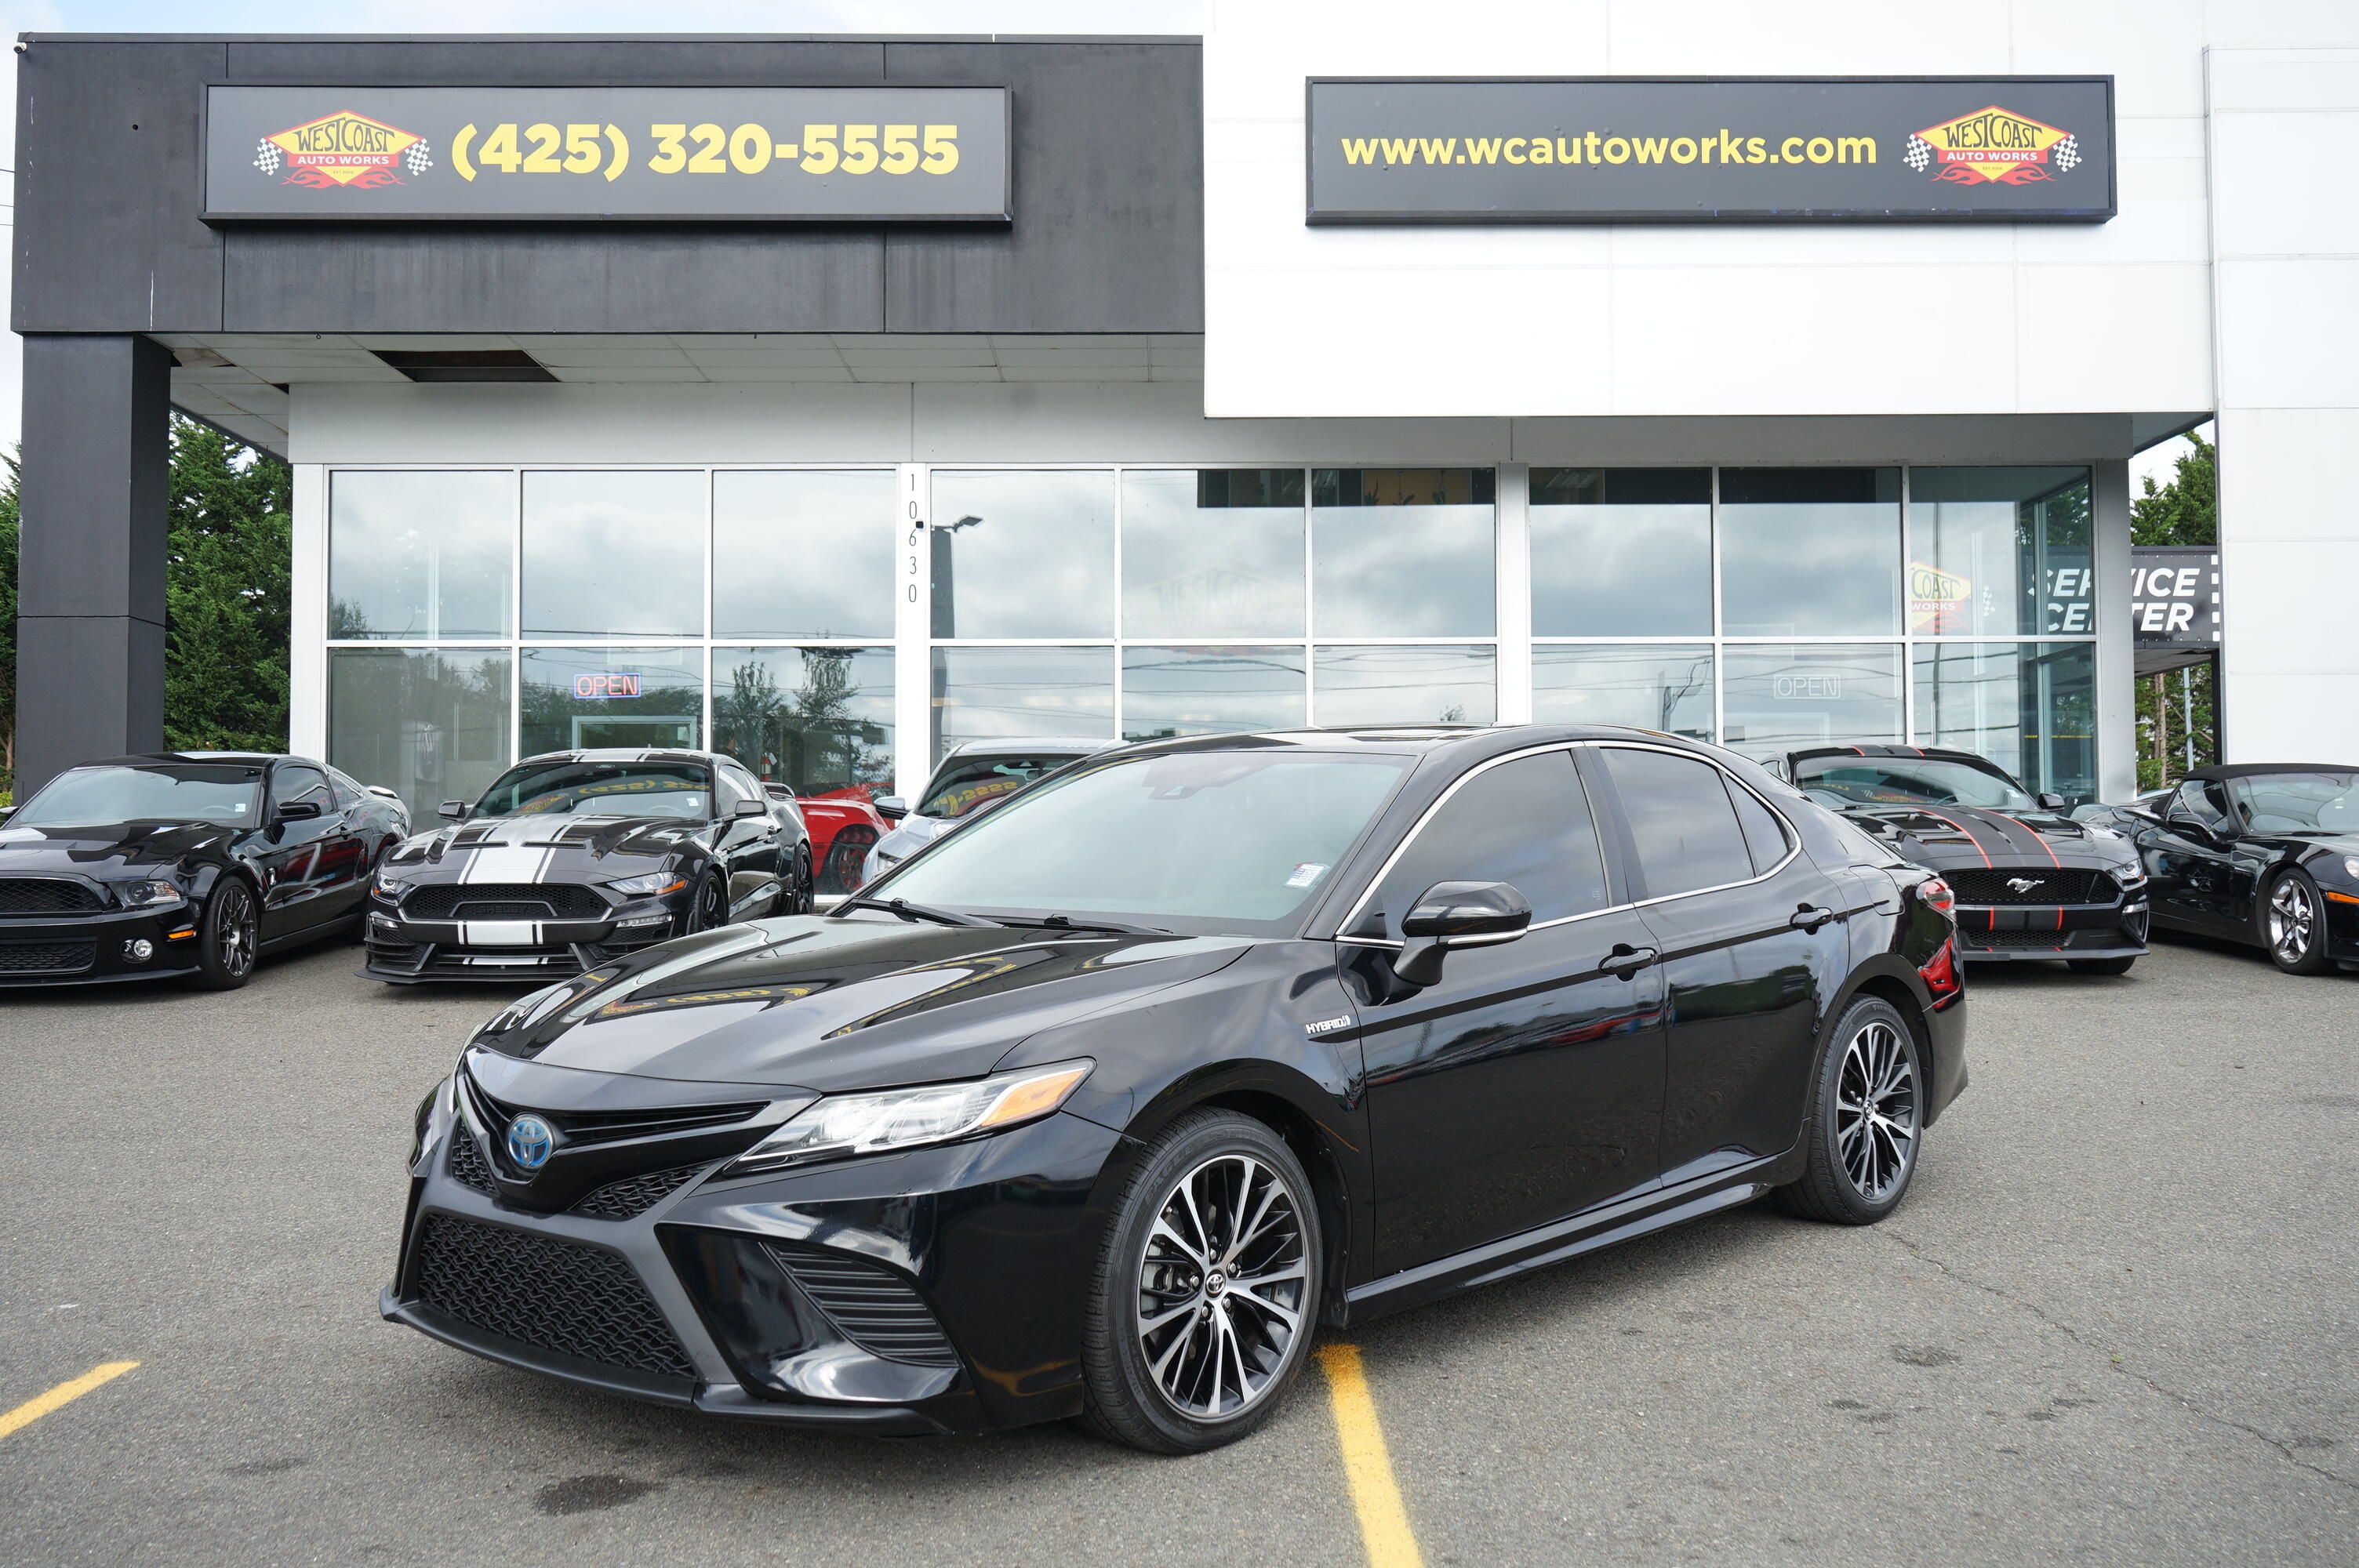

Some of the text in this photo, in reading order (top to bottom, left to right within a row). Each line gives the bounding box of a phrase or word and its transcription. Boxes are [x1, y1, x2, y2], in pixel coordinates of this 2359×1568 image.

[452, 123, 959, 182] (425) 320-5555
[1340, 129, 1877, 165] www.wcautoworks.com
[1946, 151, 2038, 161] AUTO WORKS
[297, 156, 389, 165] AUTO WORKS
[576, 676, 638, 696] OPEN
[1778, 677, 1837, 696] OPEN
[1304, 1018, 1345, 1034] HYBRID
